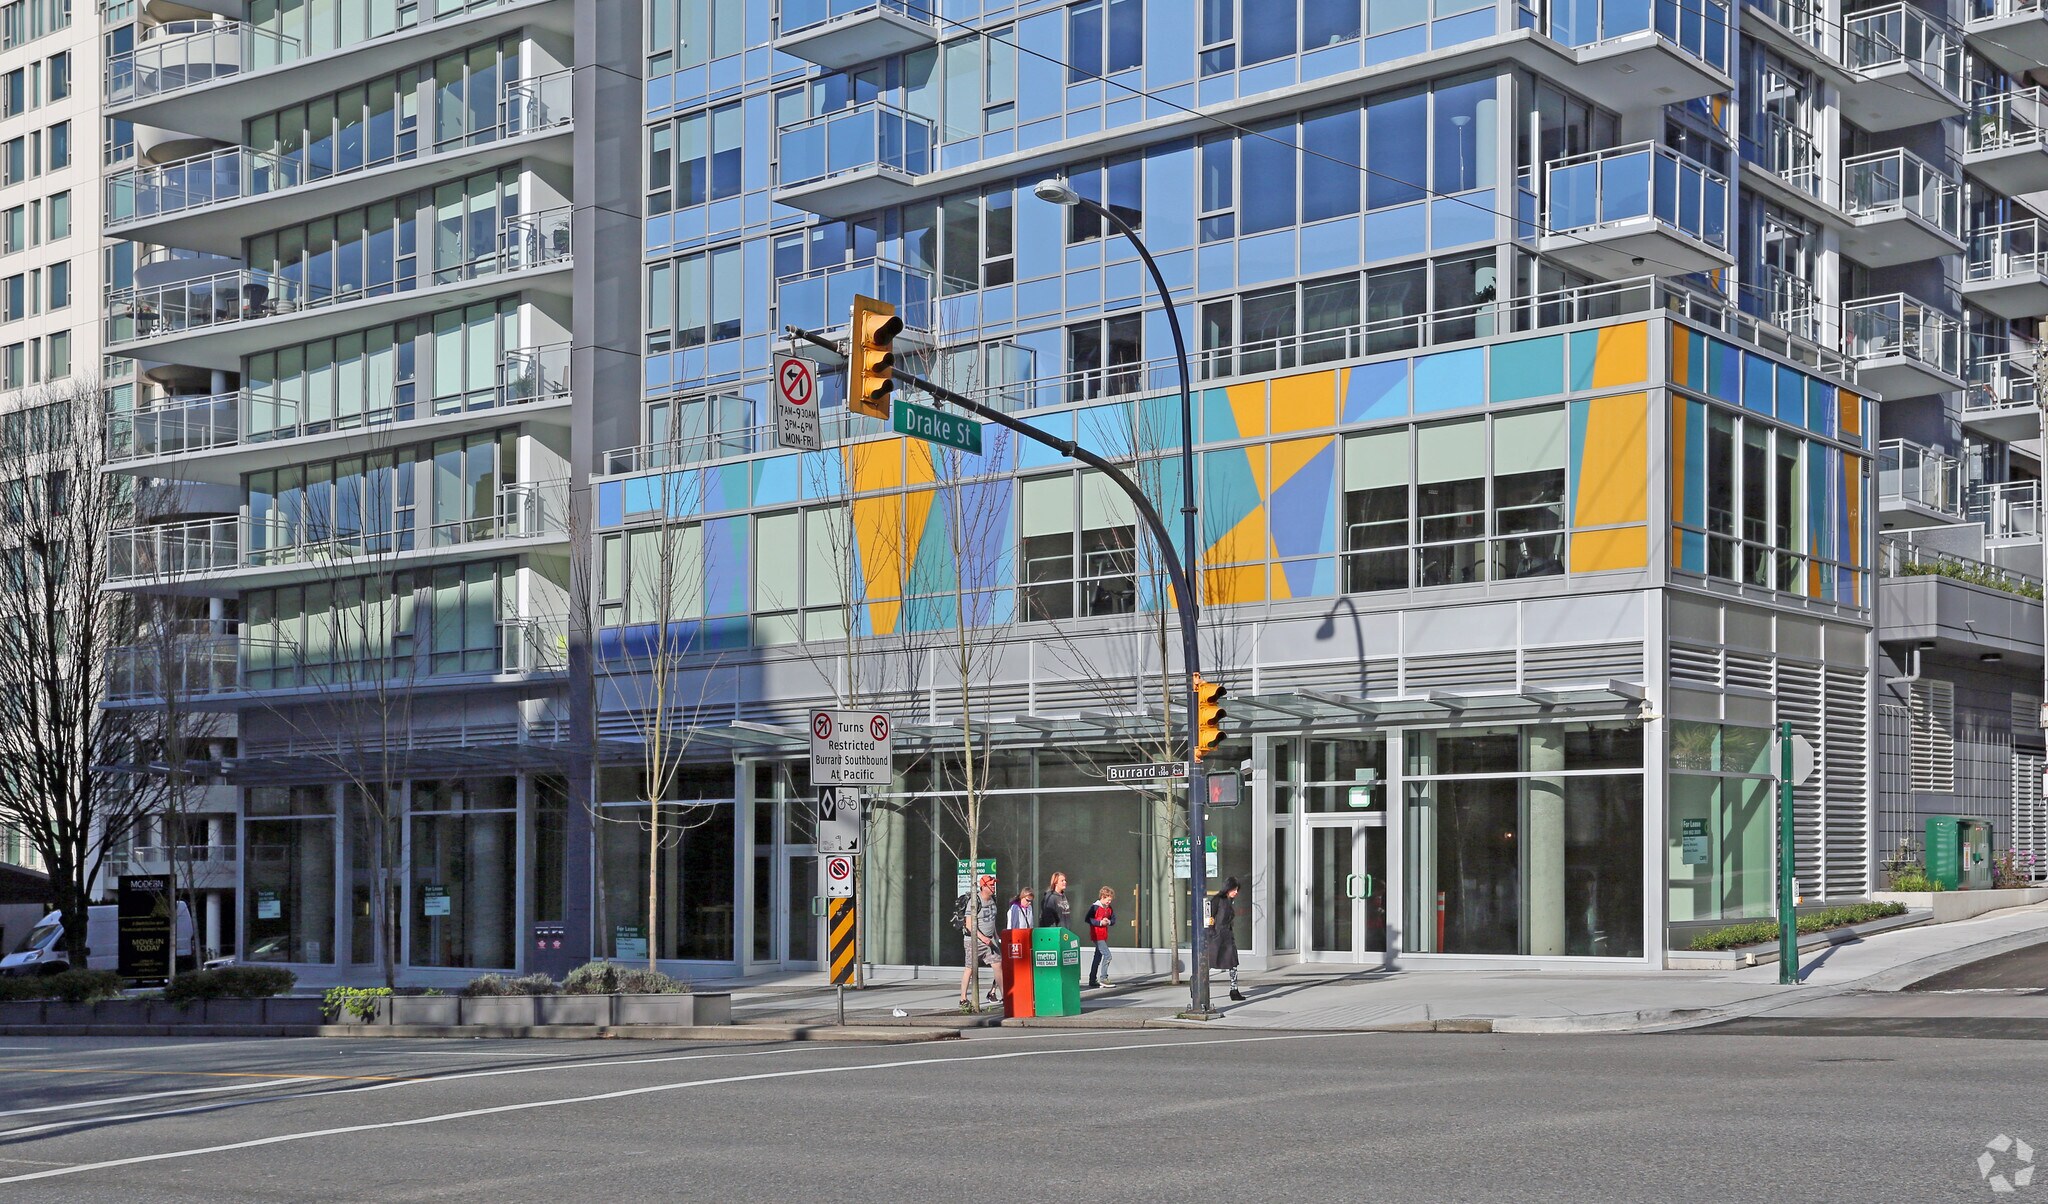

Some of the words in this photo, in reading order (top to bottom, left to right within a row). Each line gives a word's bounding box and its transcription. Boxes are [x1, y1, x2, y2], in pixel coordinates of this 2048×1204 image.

[784, 418, 813, 434] 3PM-6PM
[906, 408, 950, 440] Drake
[957, 422, 971, 446] St
[785, 432, 814, 448] MON-FRI
[838, 723, 864, 732] Turns
[829, 740, 874, 750] Restricted
[816, 755, 842, 765] Burrard
[845, 756, 887, 766] Southbound
[831, 770, 840, 779] At
[844, 769, 874, 779] Pacific
[1110, 765, 1155, 779] Burrard
[130, 880, 164, 888] MODERN
[136, 944, 160, 952] TODAY
[1037, 952, 1056, 961] metro
